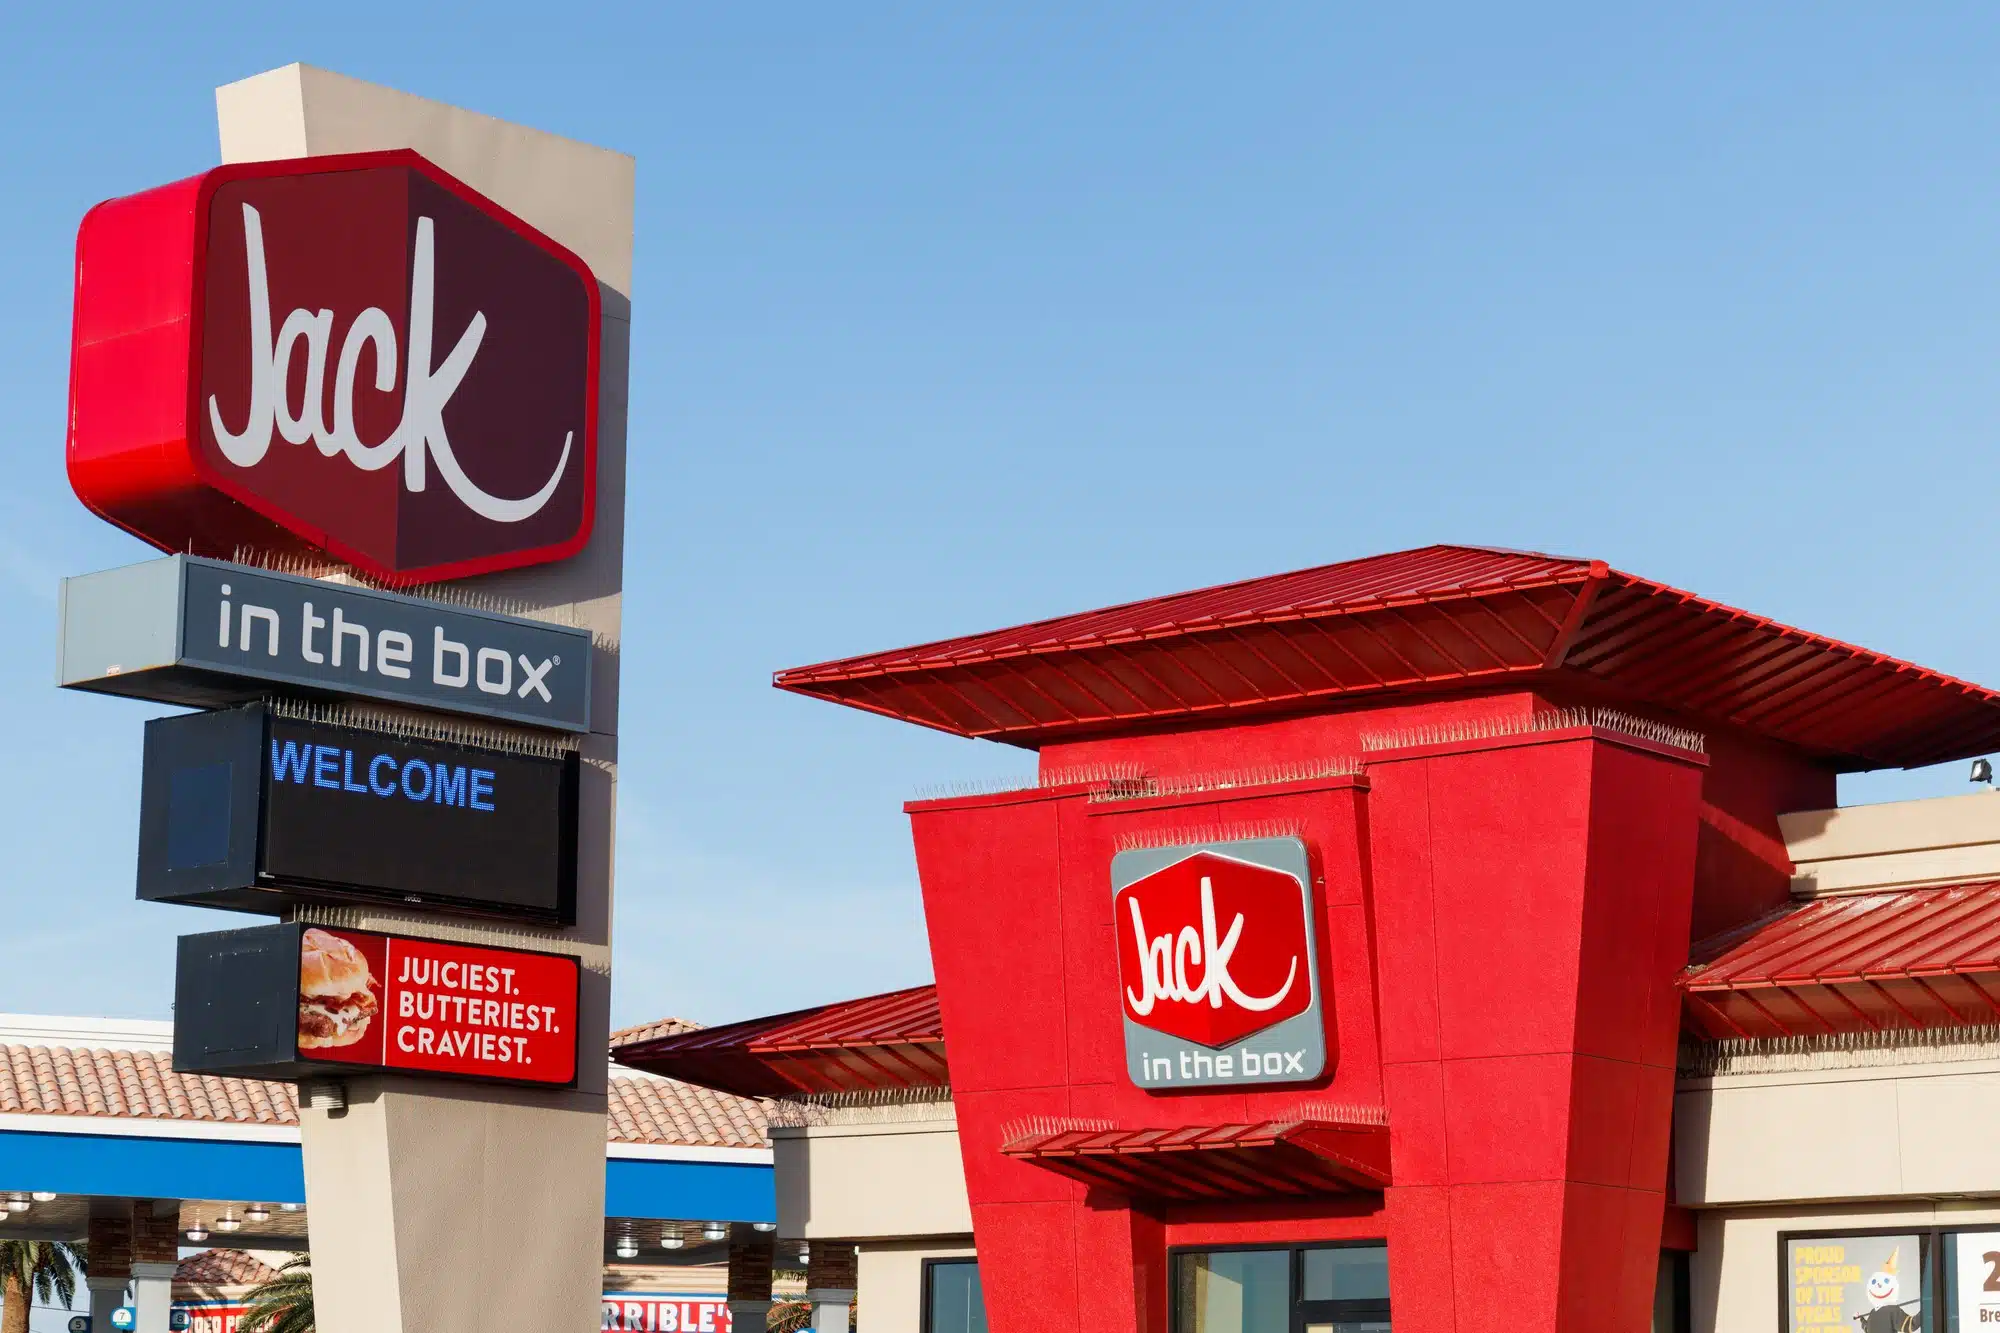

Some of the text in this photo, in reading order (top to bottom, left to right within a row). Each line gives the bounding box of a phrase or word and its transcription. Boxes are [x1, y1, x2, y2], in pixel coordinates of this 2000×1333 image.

[209, 203, 573, 522] Jack
[219, 584, 280, 657] in
[302, 601, 413, 679] the
[272, 738, 496, 812] WELCOME
[1127, 877, 1297, 1016] Jack
[398, 955, 520, 995] JUICIEST.
[398, 992, 560, 1035] BUTTERIEST.
[397, 1026, 532, 1065] CRAVIEST.
[1143, 1052, 1171, 1081] in
[1180, 1050, 1234, 1080] the
[1796, 1246, 1845, 1265] PROUD
[1796, 1266, 1862, 1285] SPONSOR
[1796, 1286, 1845, 1304] OF THE
[75, 1320, 82, 1329] 5
[119, 1311, 126, 1321] 7
[177, 1314, 184, 1323] 8
[1796, 1306, 1841, 1323] VEGAS
